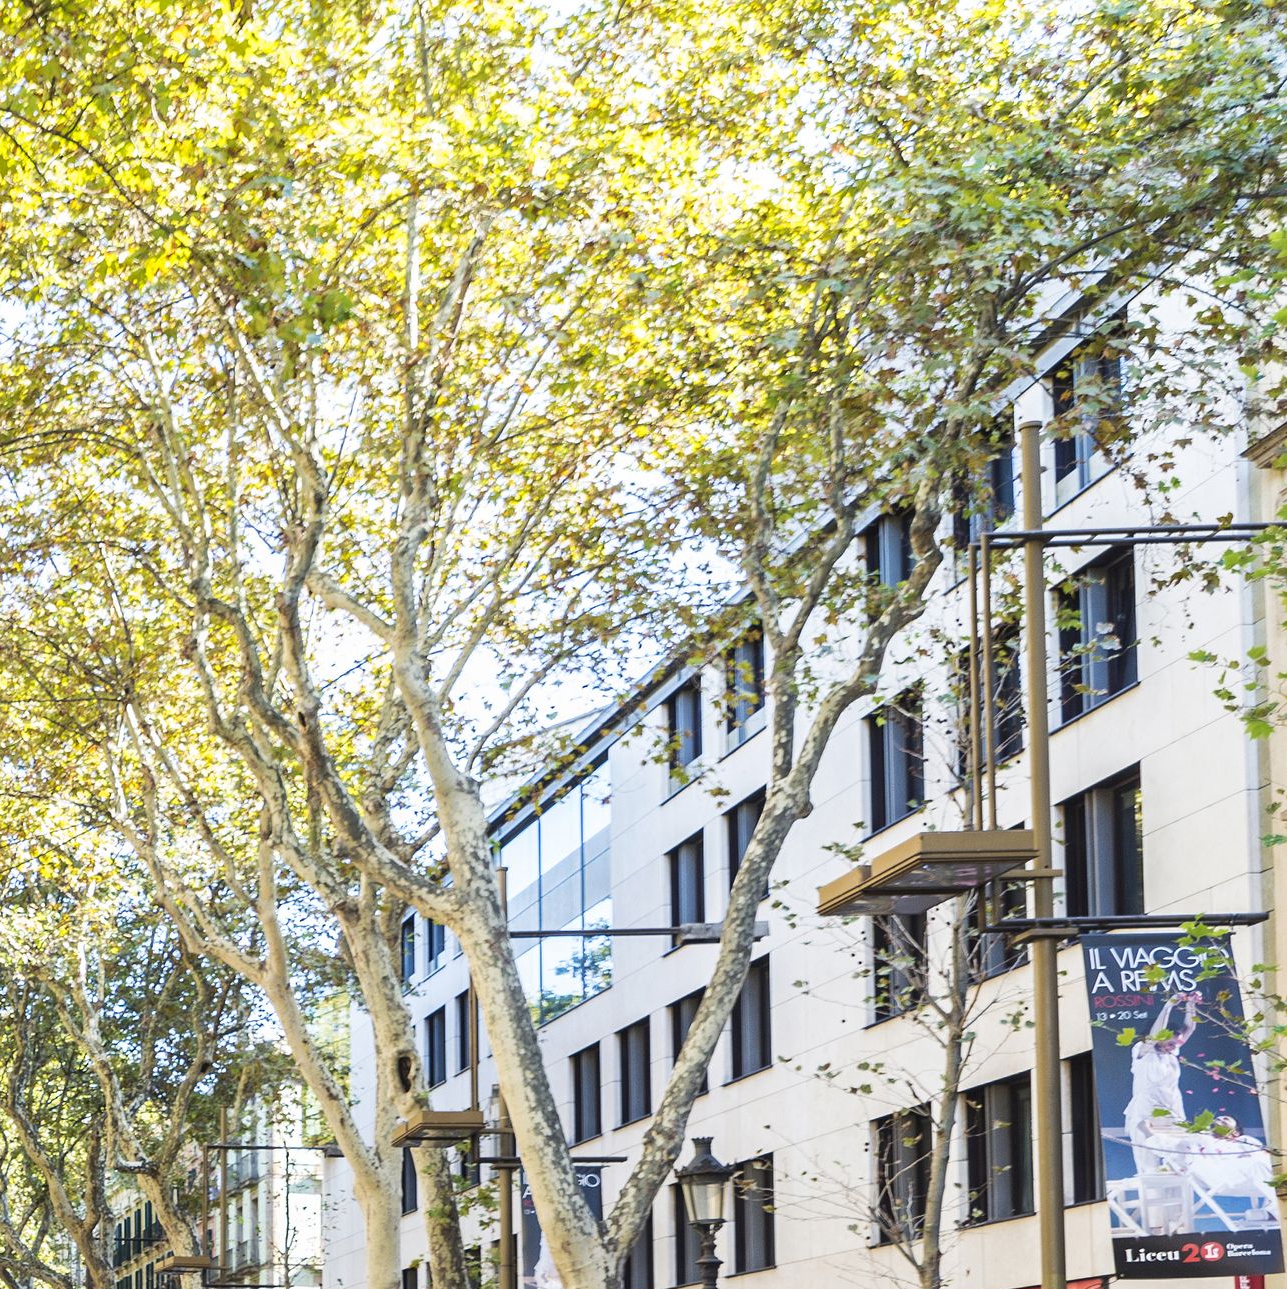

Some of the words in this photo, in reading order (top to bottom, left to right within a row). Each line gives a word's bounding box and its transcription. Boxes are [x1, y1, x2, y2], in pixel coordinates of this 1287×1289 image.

[1088, 947, 1106, 970] IL
[1091, 971, 1115, 994] A
[1093, 994, 1154, 1009] ROSSINI
[1116, 1011, 1132, 1021] 20
[1125, 1248, 1180, 1263] Liceu
